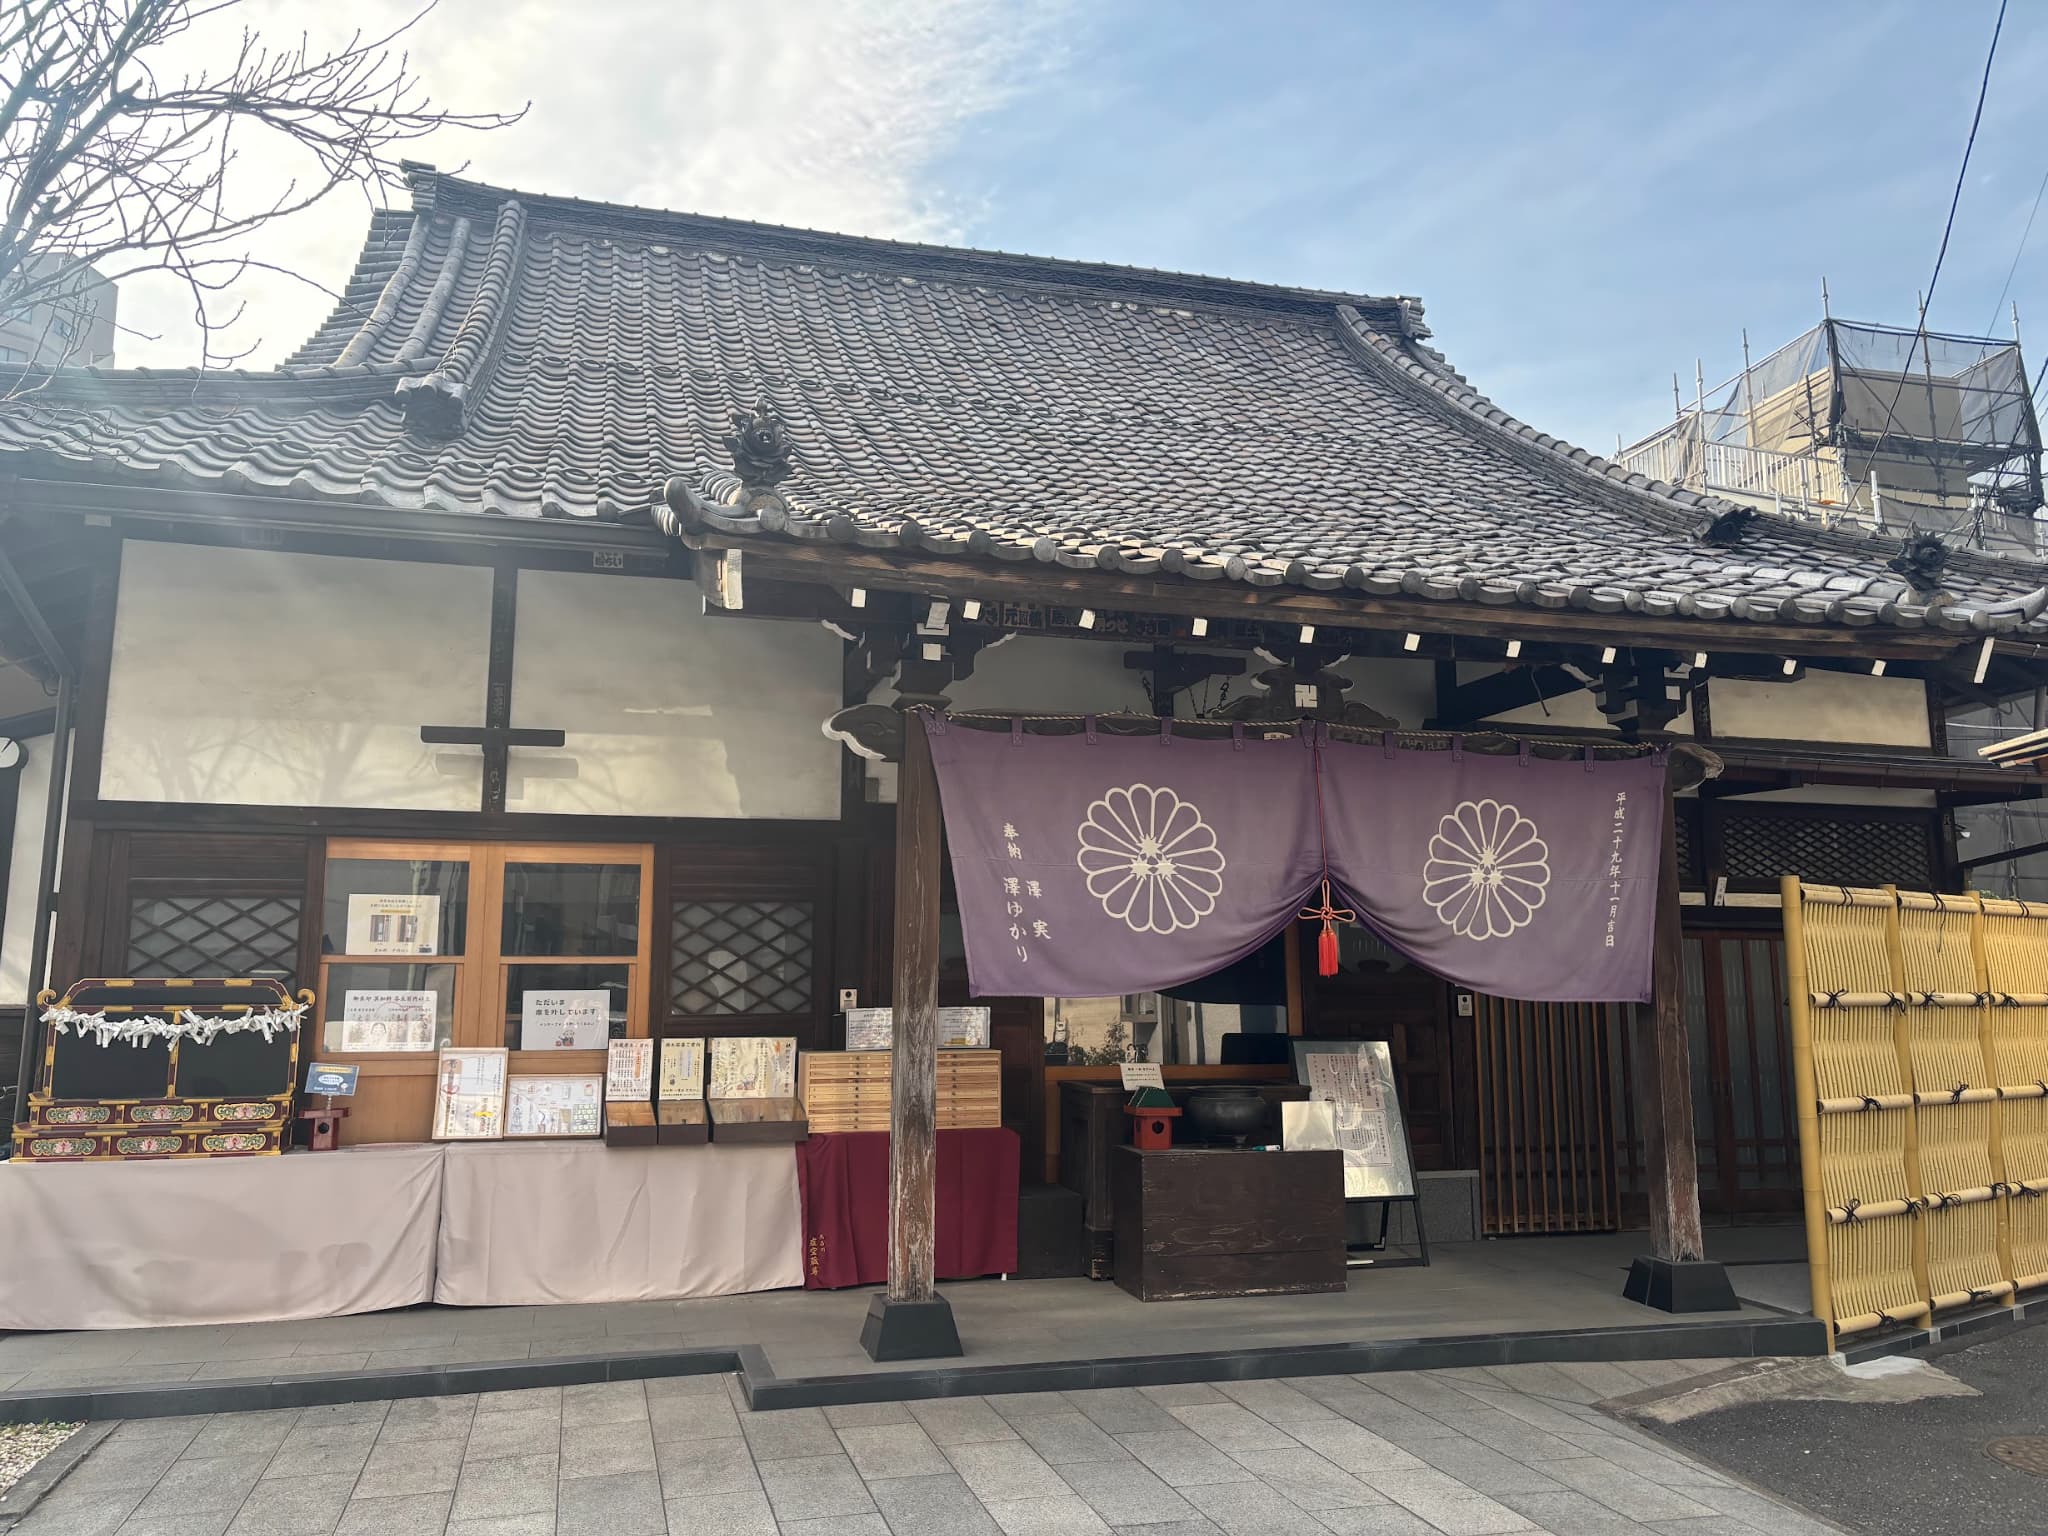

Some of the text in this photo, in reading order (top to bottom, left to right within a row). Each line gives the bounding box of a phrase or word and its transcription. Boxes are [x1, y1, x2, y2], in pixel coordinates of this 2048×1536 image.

[1003, 822, 1029, 962] 奉納 澤ゆかり
[1604, 791, 1627, 947] 平成二十九年十一月吉日
[535, 998, 566, 1006] ただいま
